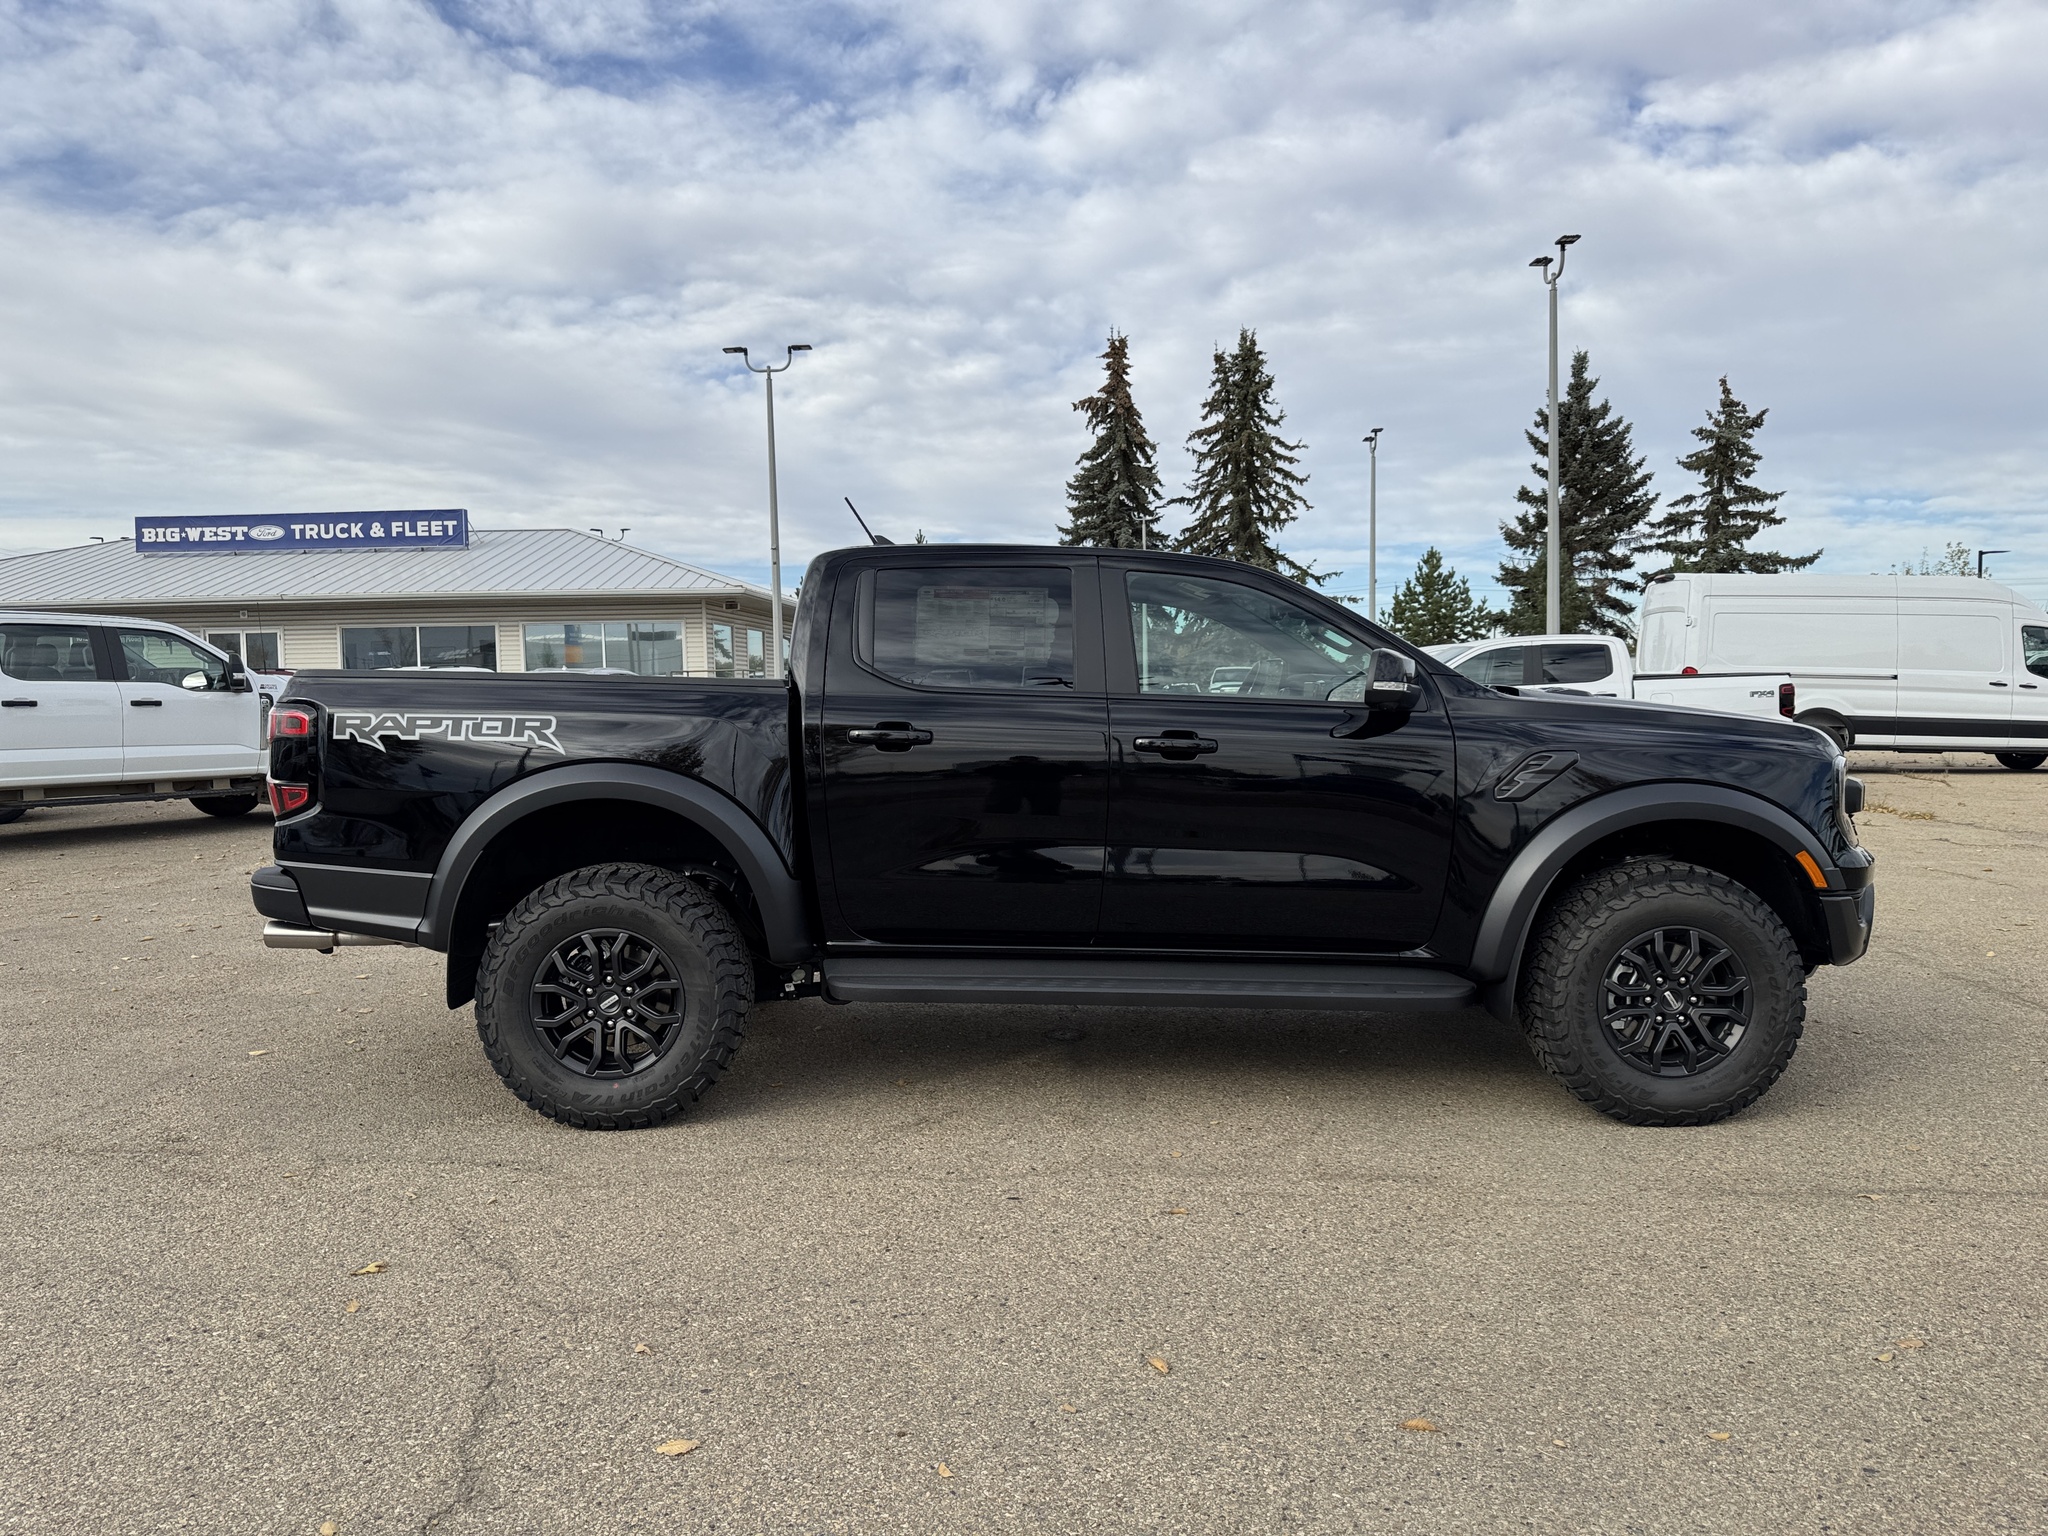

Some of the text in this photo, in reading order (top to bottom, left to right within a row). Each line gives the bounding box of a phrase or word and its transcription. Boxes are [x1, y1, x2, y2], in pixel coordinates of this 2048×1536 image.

[141, 527, 181, 542] BIG
[184, 526, 249, 541] WEST
[290, 522, 365, 540] TRUCK
[369, 521, 386, 538] &
[391, 520, 458, 537] FLEET
[332, 713, 566, 755] RAPTOR
[502, 905, 624, 998] BFGoodrich
